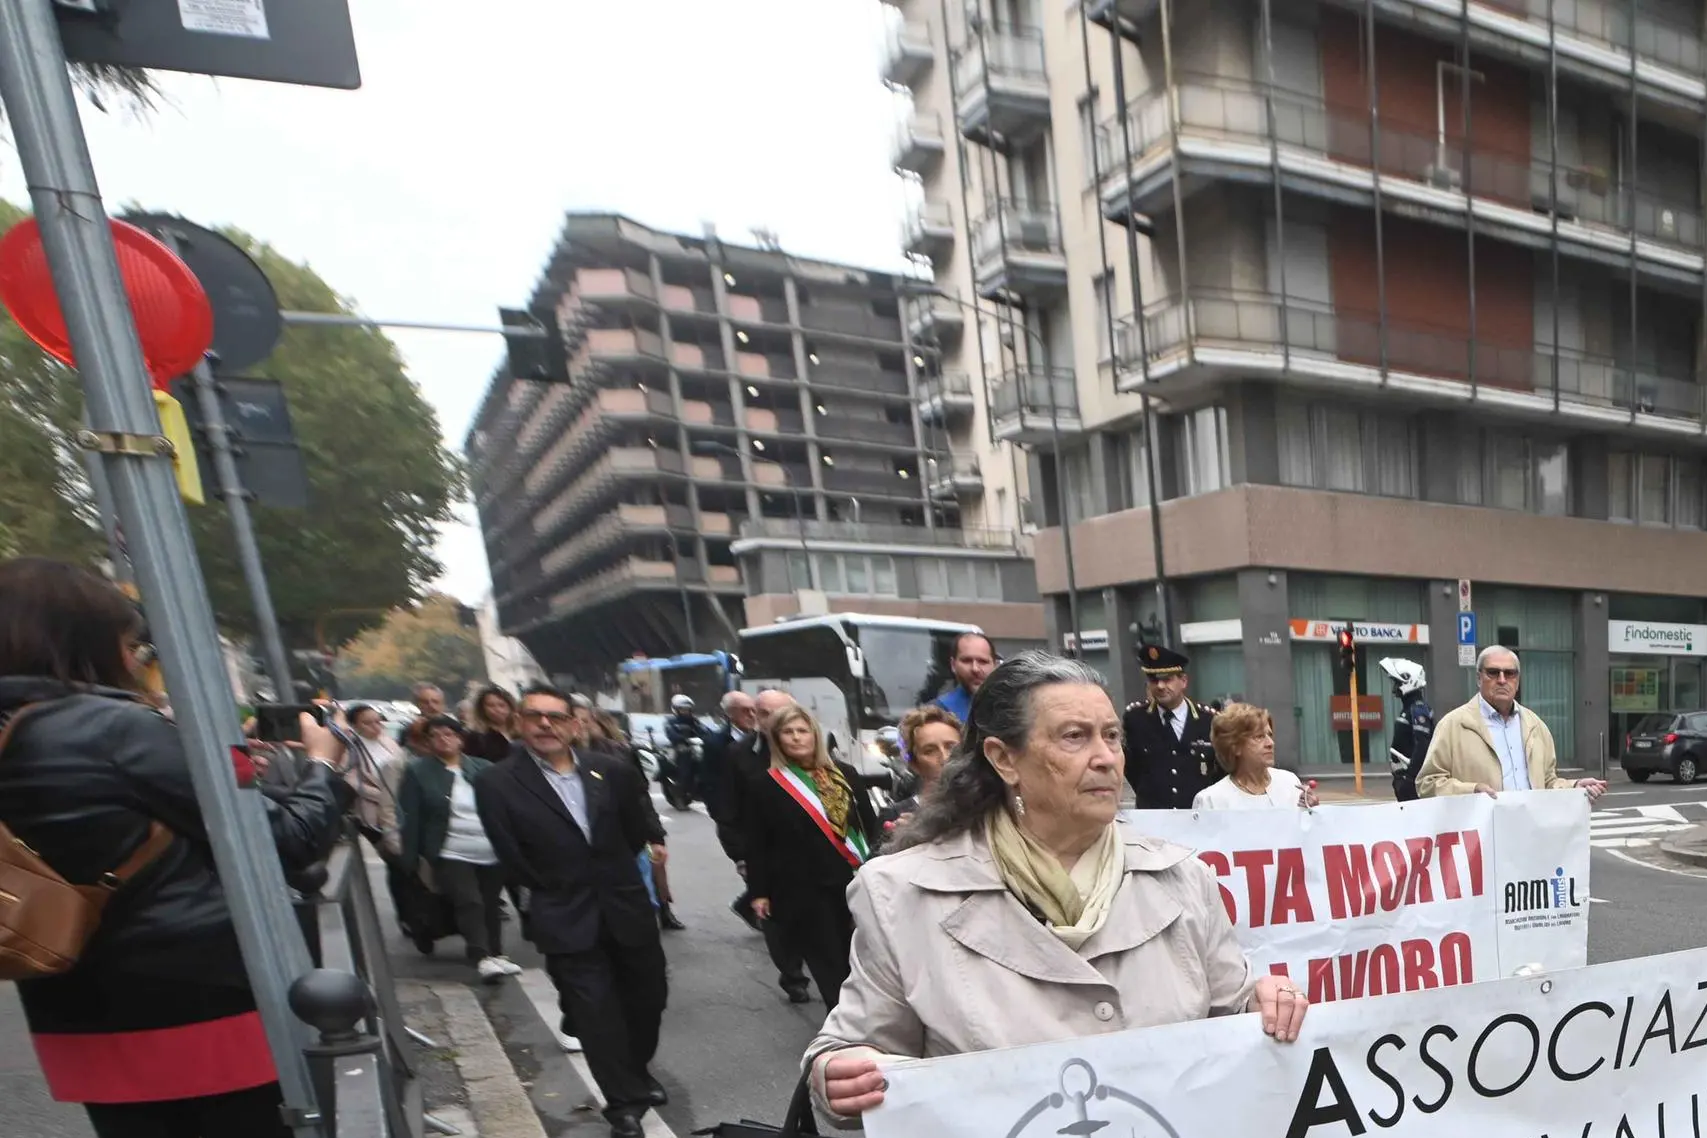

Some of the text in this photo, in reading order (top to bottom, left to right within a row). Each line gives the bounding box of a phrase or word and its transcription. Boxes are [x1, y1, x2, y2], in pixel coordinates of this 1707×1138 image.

[1370, 627, 1403, 638] BANCA
[1460, 616, 1472, 641] P
[1624, 624, 1692, 641] Findomestic
[1321, 828, 1485, 920] MORTI
[1269, 931, 1475, 1006] AVORO
